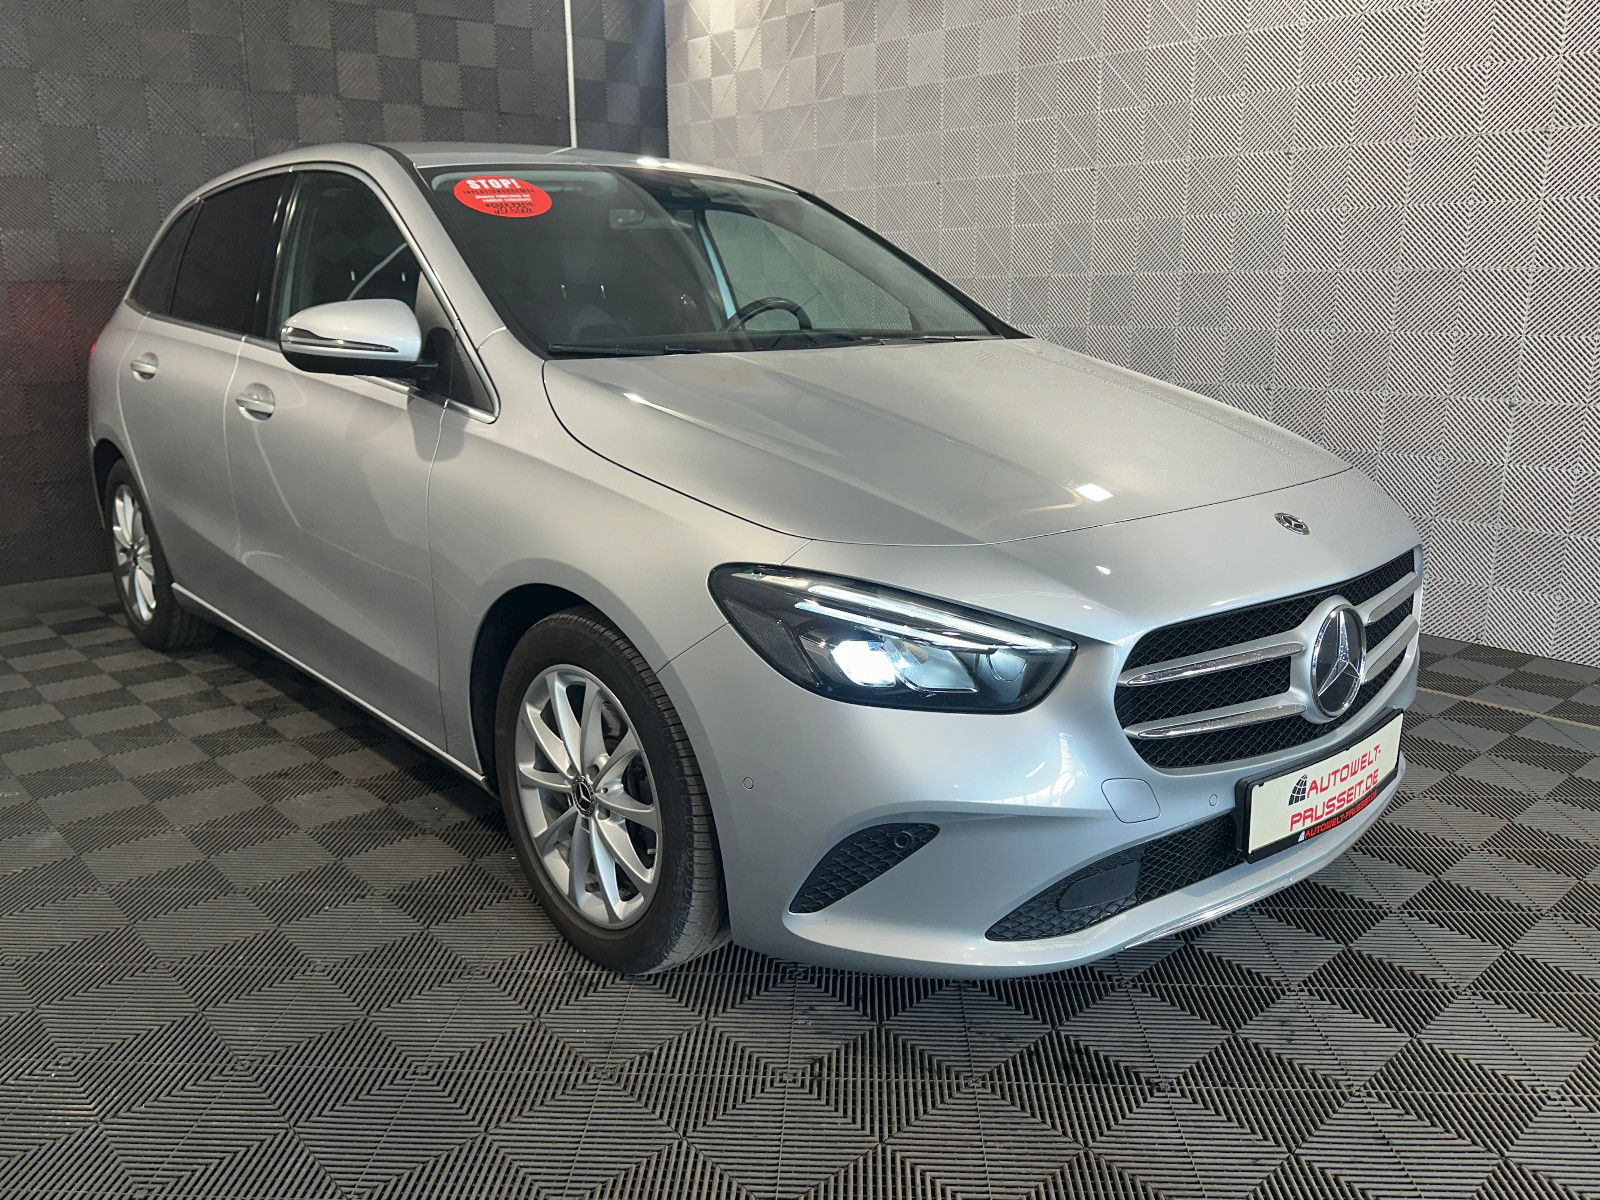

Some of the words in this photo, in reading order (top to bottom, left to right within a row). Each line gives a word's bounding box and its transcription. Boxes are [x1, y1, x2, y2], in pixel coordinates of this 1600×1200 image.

[466, 178, 522, 190] STOP!
[1306, 744, 1382, 799] AUTOWELT-
[1290, 768, 1380, 832] PRUSSEIT.DE
